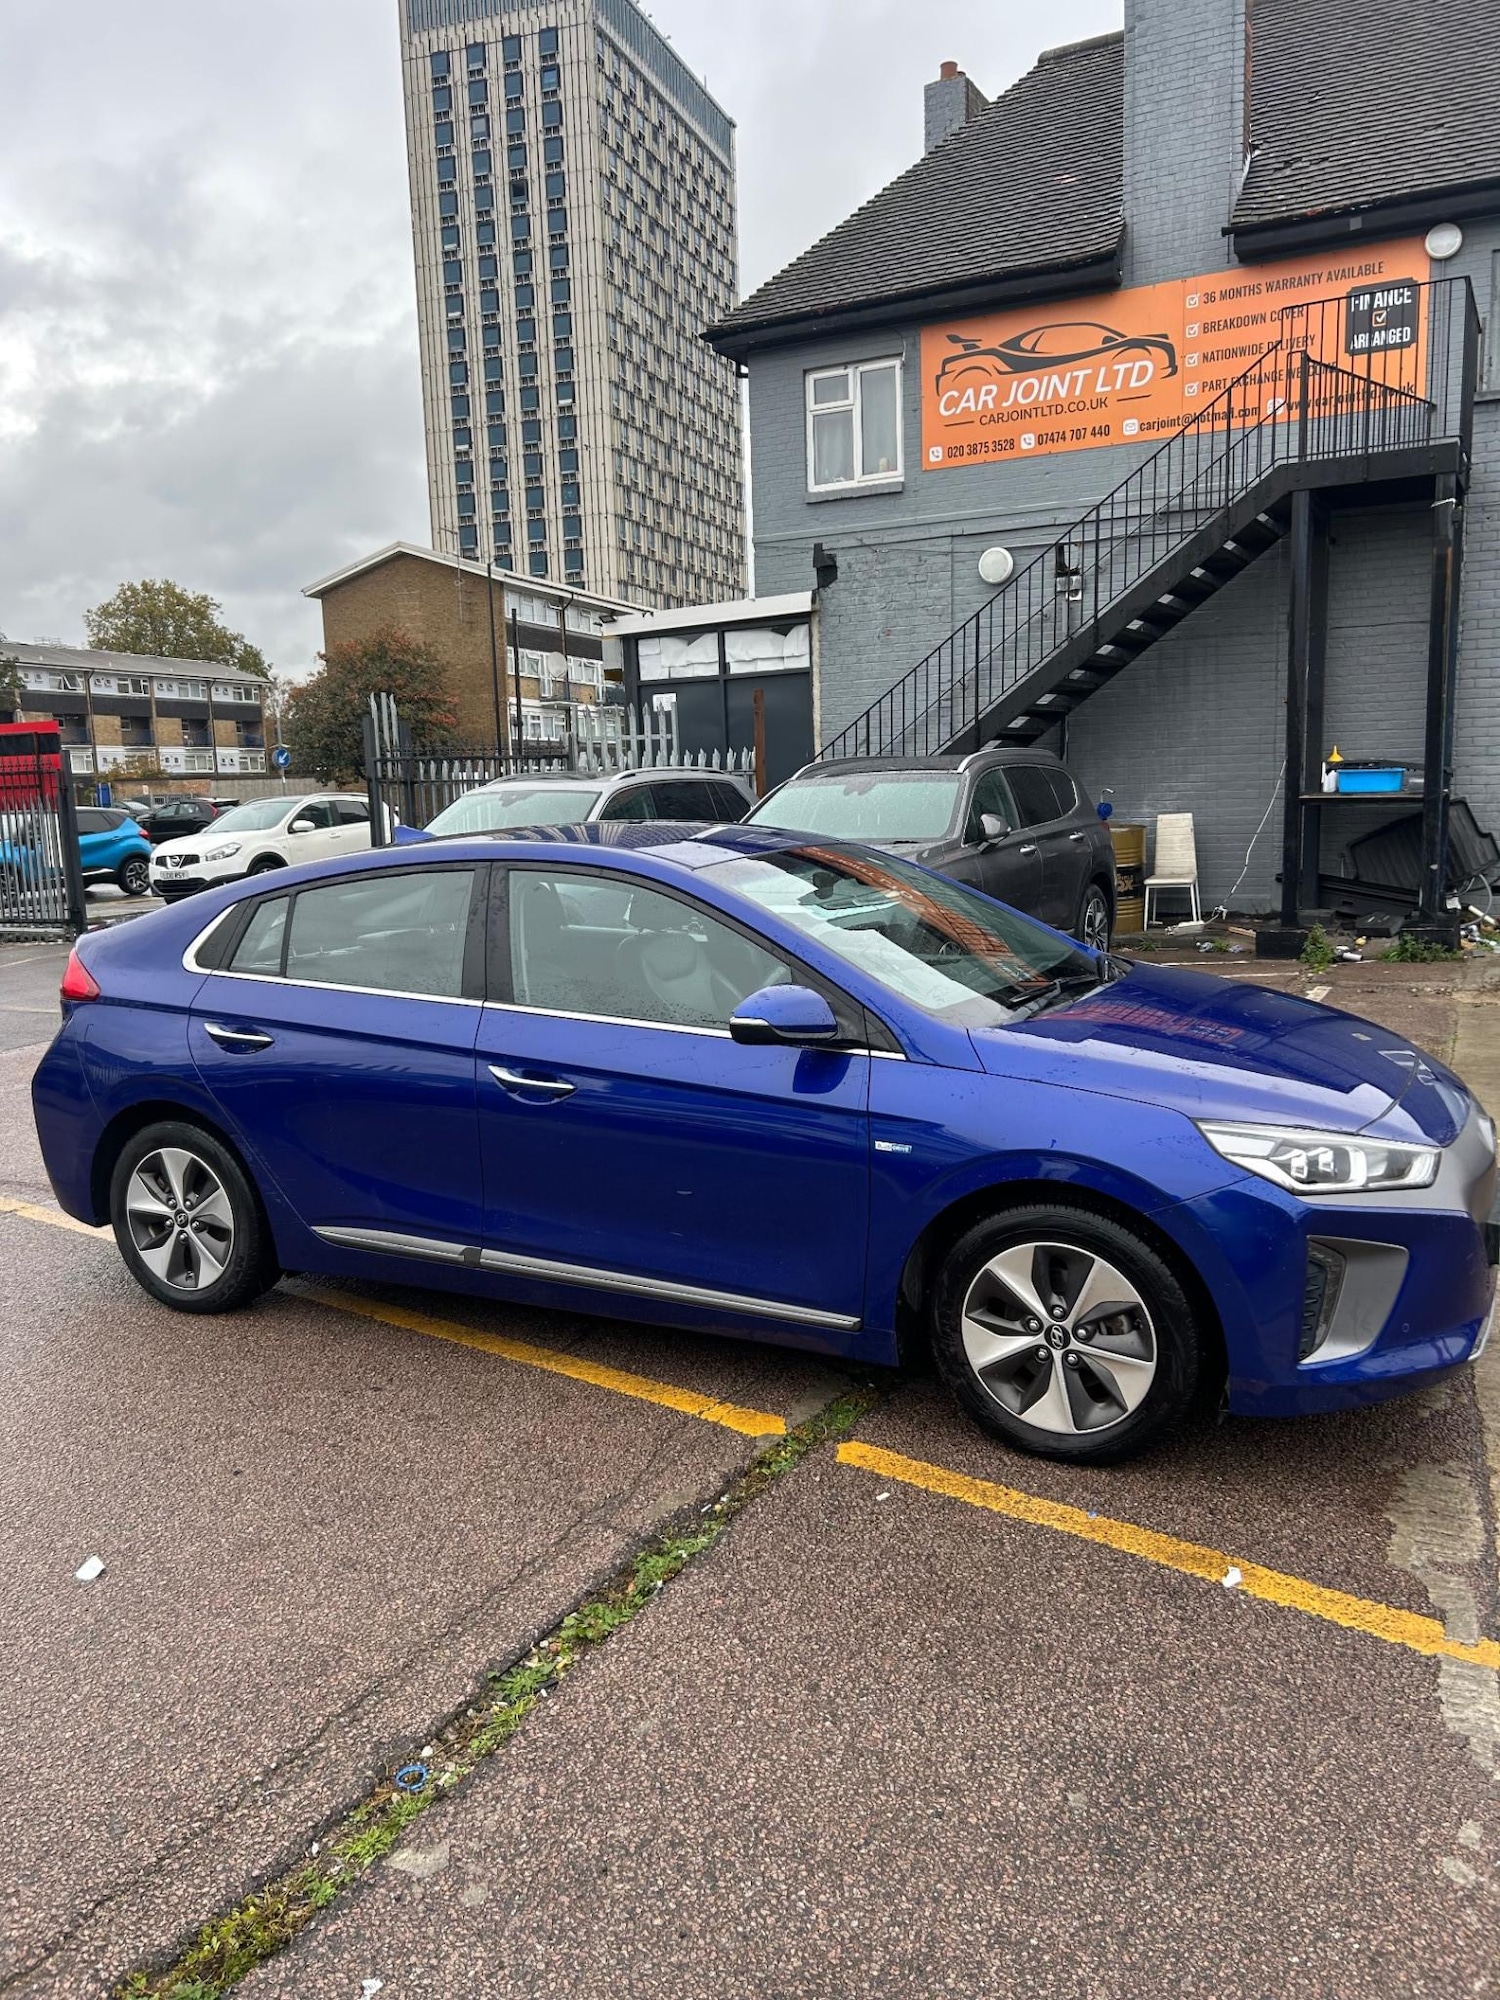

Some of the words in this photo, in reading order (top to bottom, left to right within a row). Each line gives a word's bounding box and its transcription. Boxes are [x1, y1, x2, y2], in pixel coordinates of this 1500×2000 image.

[1203, 291, 1216, 304] 36
[1219, 283, 1262, 301] MONTHS
[1266, 272, 1323, 294] WARRANTY
[1326, 261, 1384, 283] AVAILABLE
[1203, 312, 1266, 334] BREAKDOWN
[1270, 307, 1304, 323] COVER
[1202, 342, 1264, 363] NATIONWIDE
[1267, 335, 1316, 354] DELIVERY
[939, 384, 998, 417] CAR
[1001, 368, 1092, 408] JOINT
[1095, 360, 1154, 394] LTD
[1202, 378, 1227, 393] PART
[1230, 369, 1284, 388] EXCHANGE
[979, 397, 1108, 426] CARJOINTLTD.CO.UK
[1140, 406, 1260, 432] carjoint@hotmal.com
[947, 443, 965, 459] 020
[967, 440, 990, 457] 3875
[991, 438, 1015, 453] 3528
[1037, 431, 1067, 446] 07474
[1070, 427, 1087, 442] 707
[1091, 424, 1110, 439] 440
